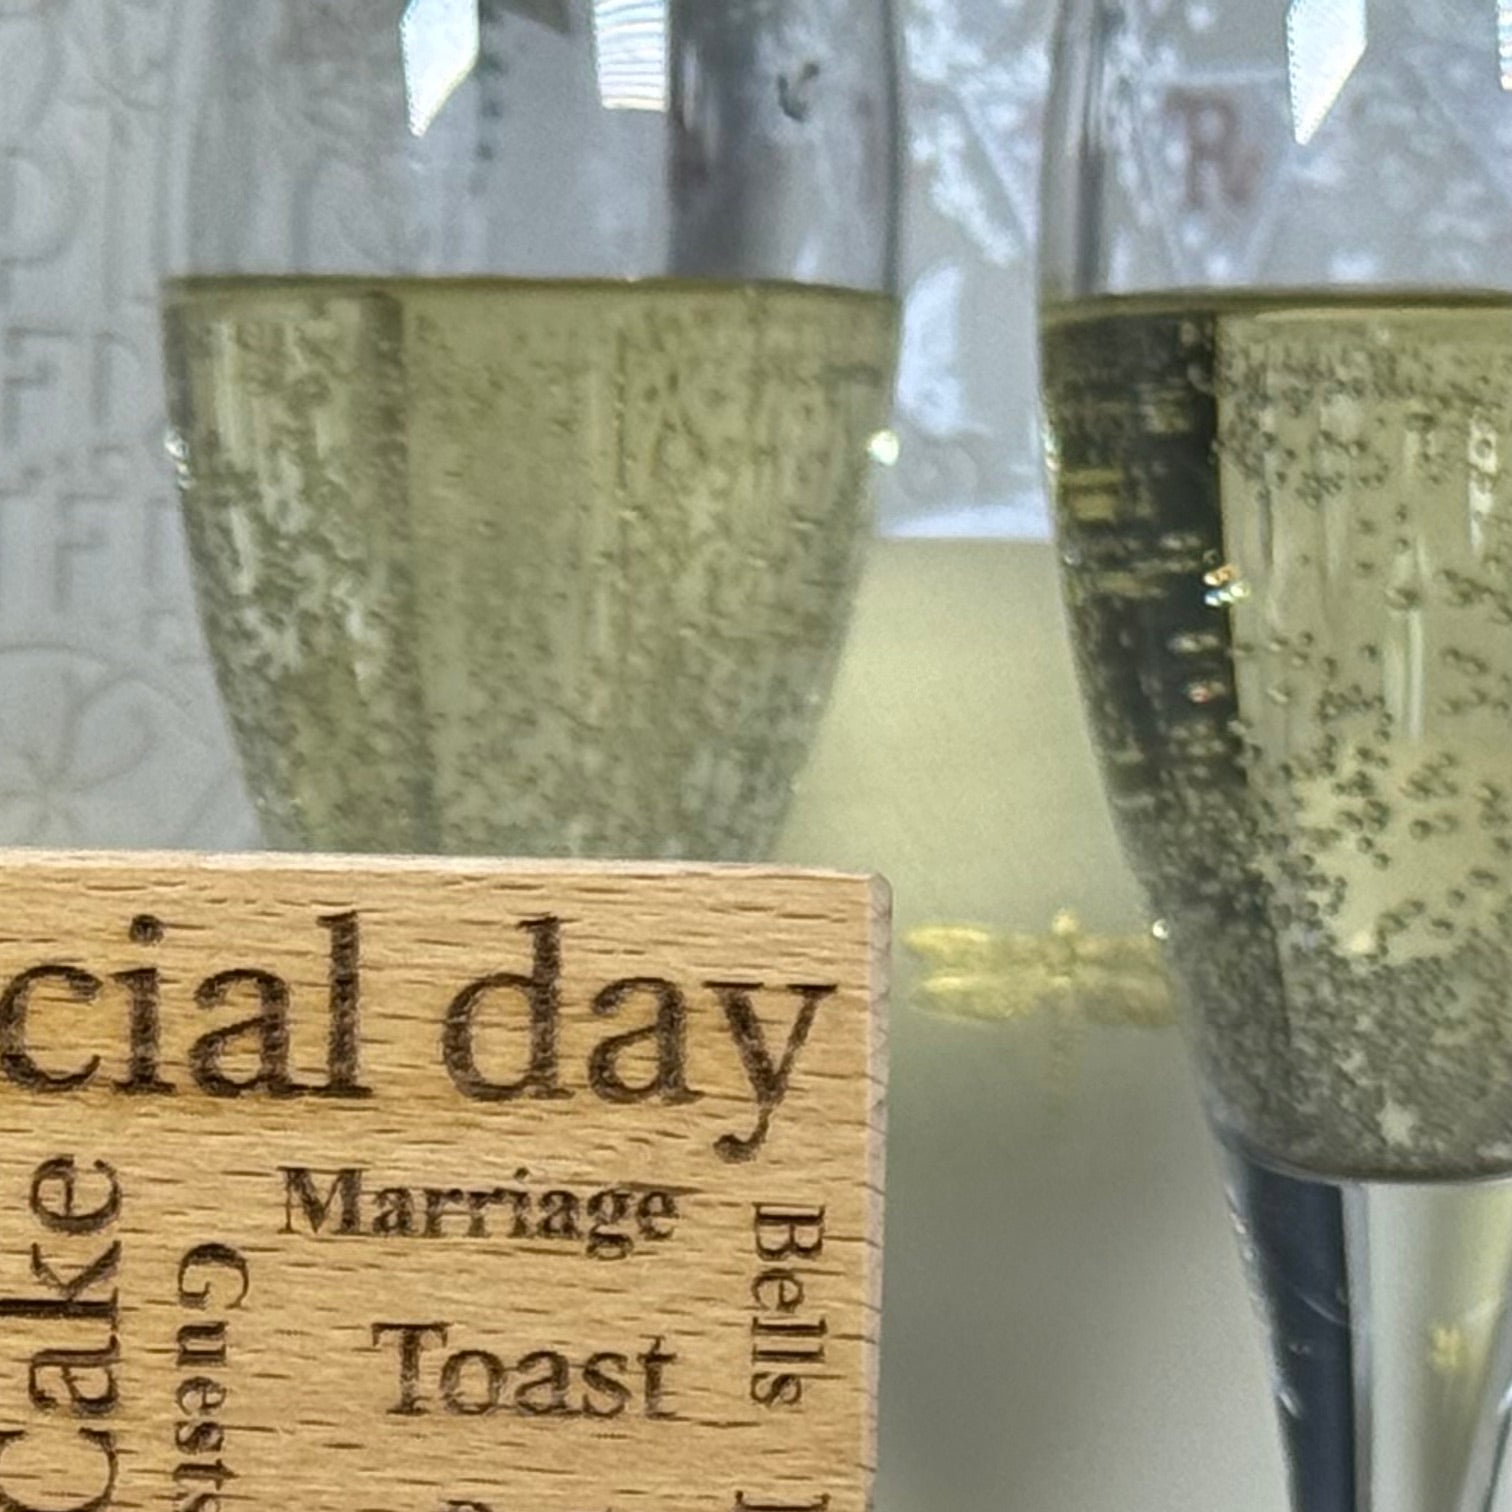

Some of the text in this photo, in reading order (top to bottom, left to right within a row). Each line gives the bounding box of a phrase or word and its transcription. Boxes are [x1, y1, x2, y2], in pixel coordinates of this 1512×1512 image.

[439, 911, 839, 1162] day
[281, 1166, 681, 1261] Marriage
[371, 1321, 682, 1421] Toast
[750, 1203, 829, 1408] Bells
